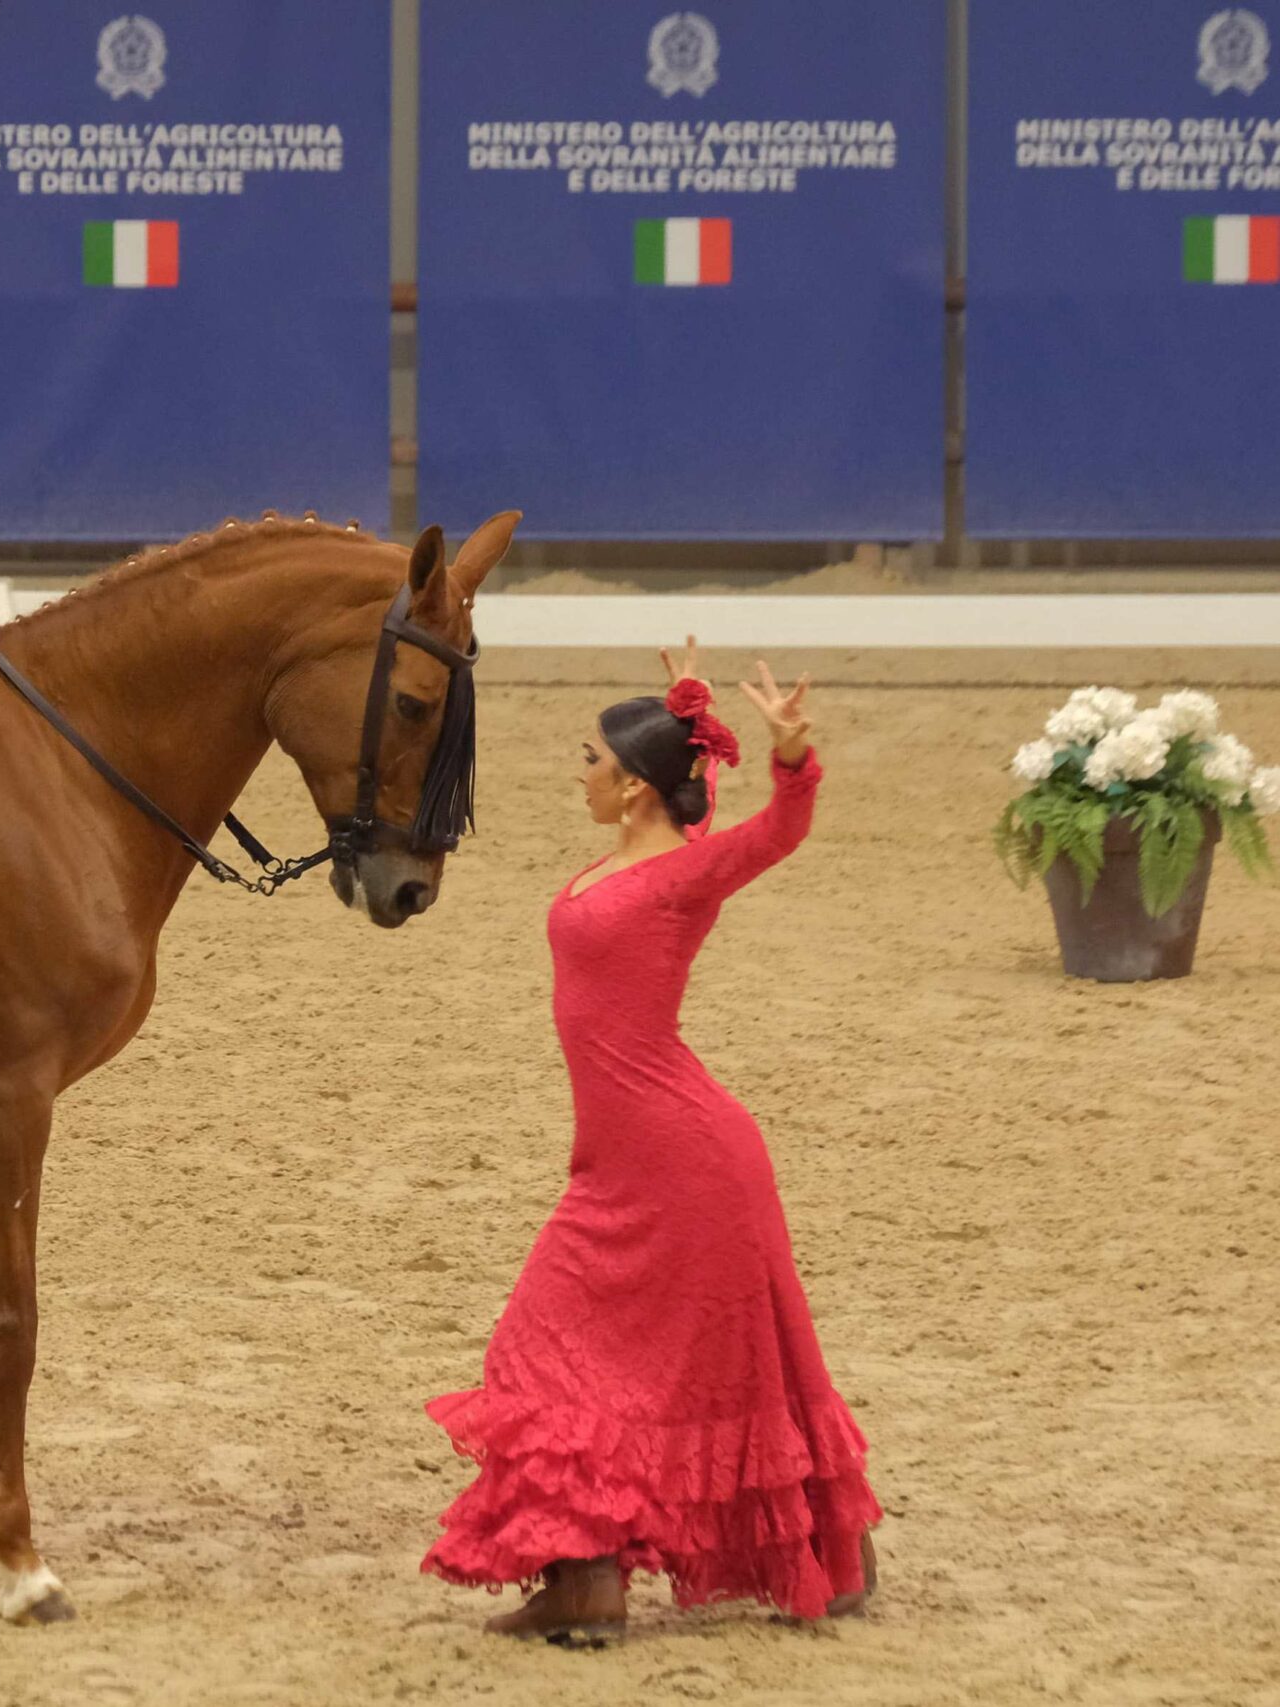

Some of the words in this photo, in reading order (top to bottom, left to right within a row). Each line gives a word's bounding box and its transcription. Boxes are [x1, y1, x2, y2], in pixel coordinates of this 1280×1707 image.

[80, 124, 342, 147] DELL'AGRICOLTURA
[469, 121, 622, 144] MINISTERO
[1016, 119, 1172, 142] MINISTERO
[170, 147, 342, 169] ALIMENTARE
[469, 145, 551, 167] DELLA
[722, 145, 895, 167] ALIMENTARE
[1017, 142, 1099, 166] DELLA
[18, 170, 33, 193] E
[41, 170, 118, 193] DELLE
[127, 170, 242, 193] FORESTE
[568, 168, 584, 191] E
[591, 168, 670, 191] DELLE
[679, 168, 795, 191] FORESTE
[1117, 166, 1133, 190] E
[1140, 165, 1219, 190] DELLE
